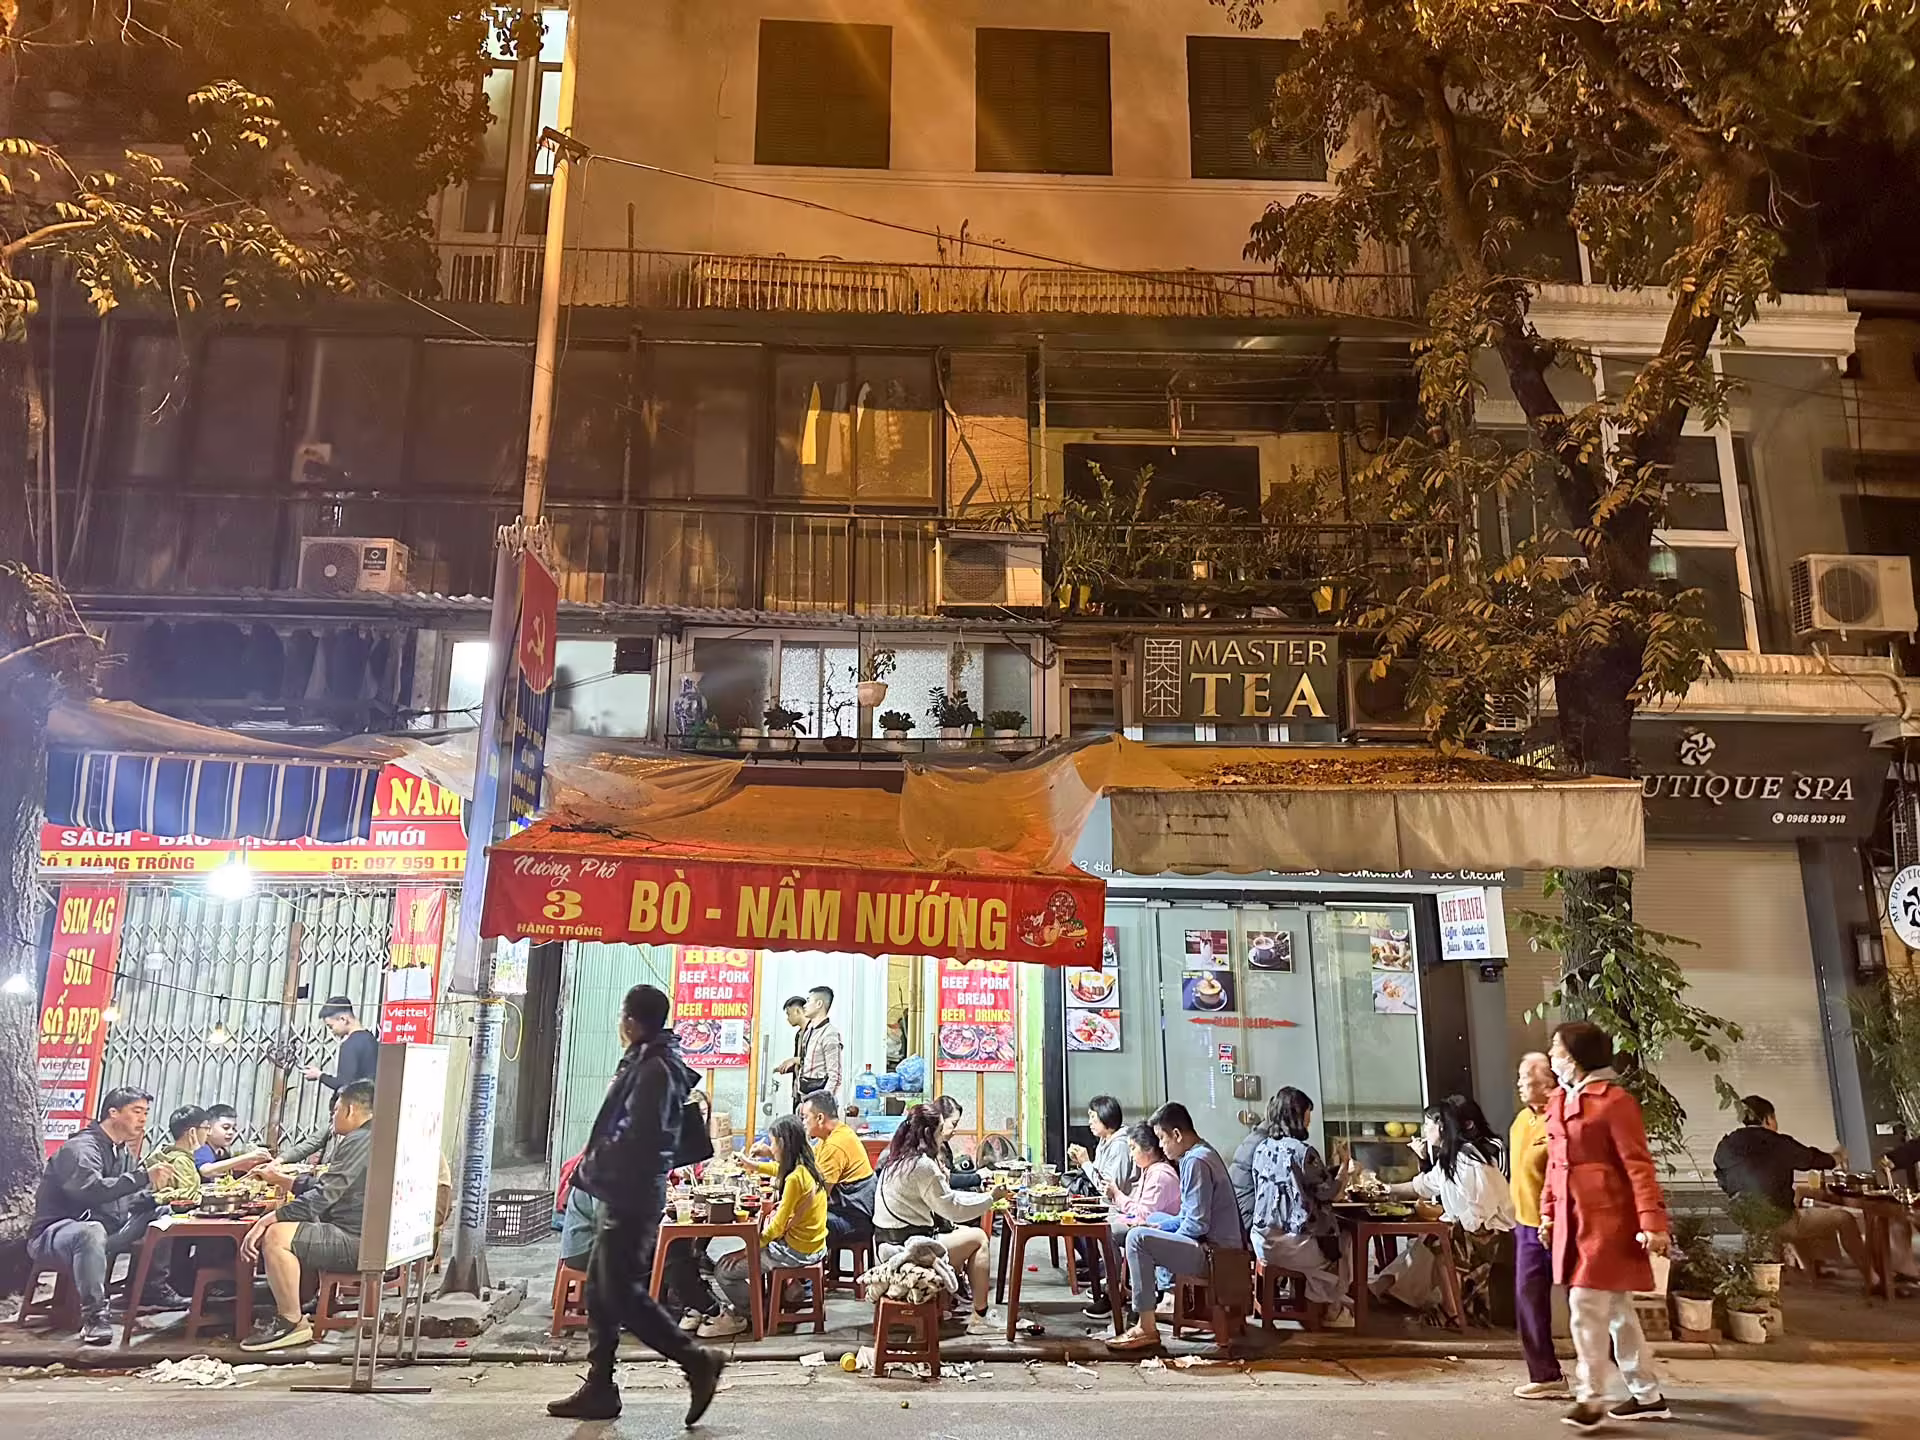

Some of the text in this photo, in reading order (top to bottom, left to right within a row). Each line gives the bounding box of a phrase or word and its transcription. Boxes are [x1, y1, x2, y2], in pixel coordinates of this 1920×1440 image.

[1189, 640, 1328, 666] MASTER
[1189, 672, 1330, 718] TEA
[1638, 775, 1854, 805] UTIQUE SPA
[1786, 814, 1847, 825] 0966 939 918
[60, 828, 132, 846] SÁCH
[375, 826, 426, 846] MỚI
[365, 857, 396, 869] 097
[403, 857, 434, 869] 959
[443, 857, 468, 869] 11
[542, 889, 584, 920] 3
[629, 869, 691, 935] BÒ
[736, 869, 841, 941] NẦM
[855, 880, 1008, 950] NƯỚNG
[1458, 896, 1485, 921] TRAVEL
[61, 896, 116, 935] SIM 4G
[516, 922, 555, 935] HÀNG
[685, 949, 748, 967] BBQ
[63, 948, 96, 985] SIM
[679, 970, 709, 984] BEEF
[718, 970, 750, 984] PORK
[942, 976, 970, 989] BEEF
[980, 976, 1010, 990] PORK
[694, 986, 734, 1000] BREAD
[957, 992, 995, 1006] BREAD
[40, 988, 68, 1045] SỐ
[387, 1007, 428, 1018] viettel
[677, 1003, 703, 1016] BEER
[711, 1003, 748, 1017] DRINKS
[942, 1008, 966, 1022] BEER
[975, 1009, 1010, 1022] DRINKS
[41, 1060, 86, 1071] viettel
